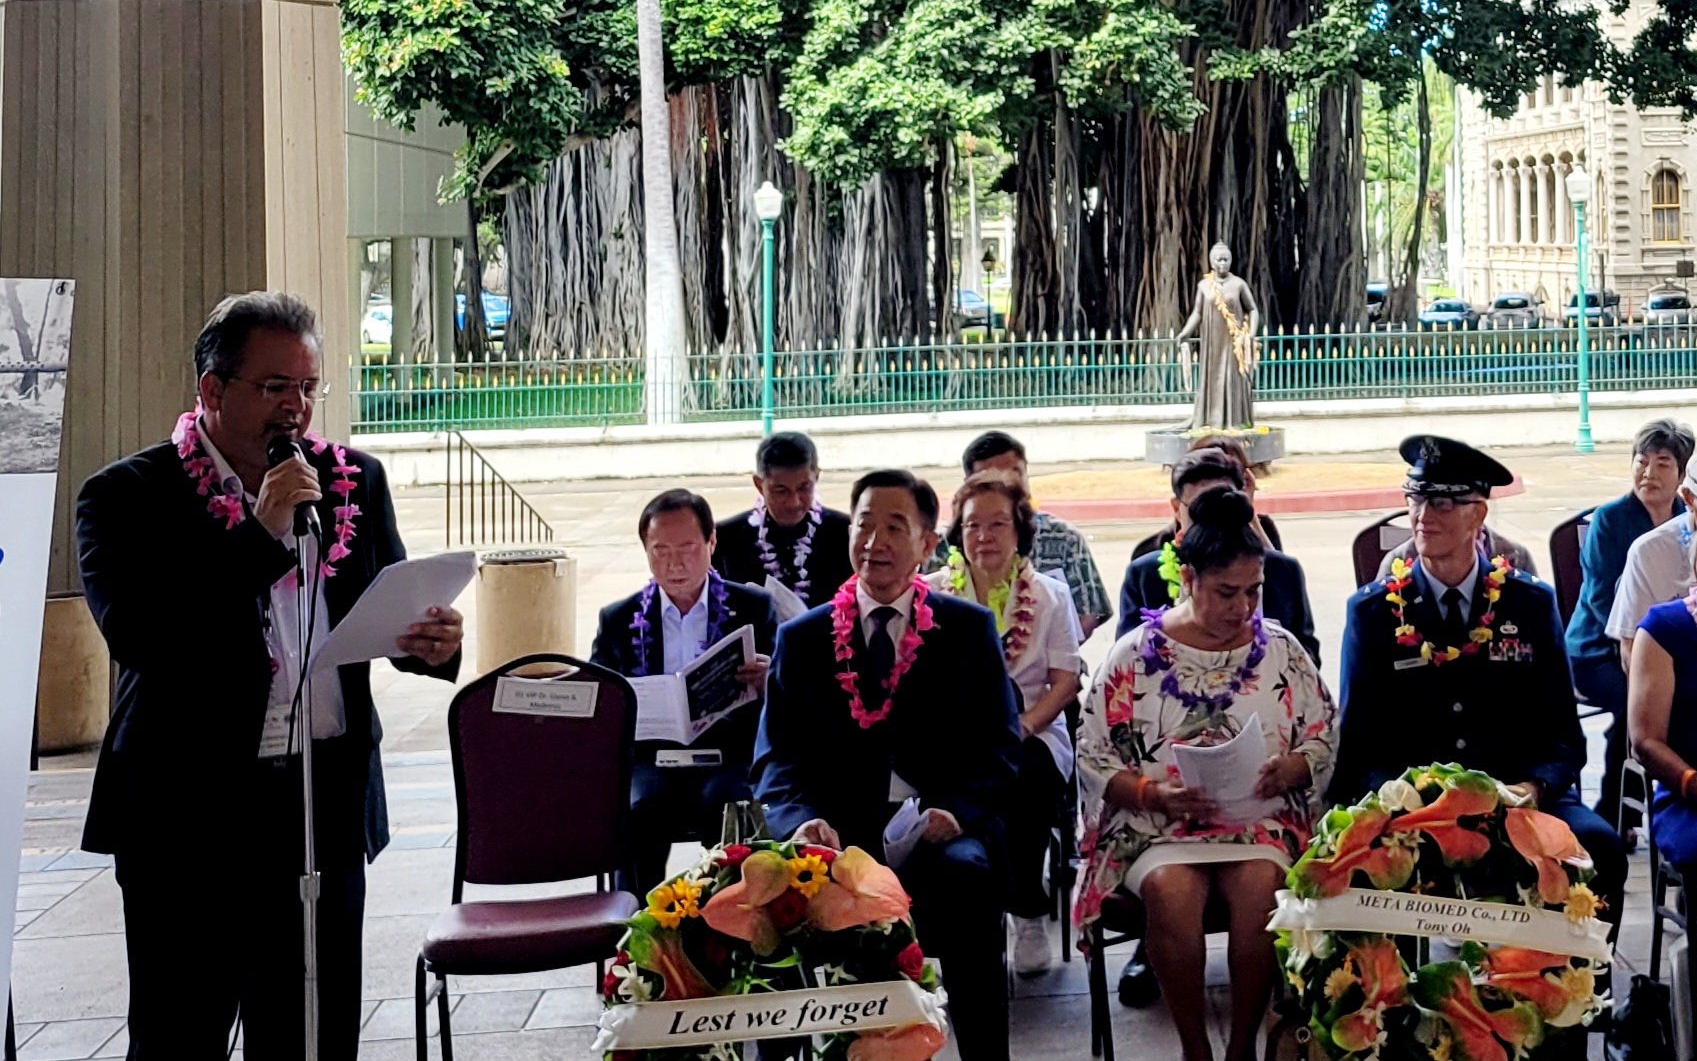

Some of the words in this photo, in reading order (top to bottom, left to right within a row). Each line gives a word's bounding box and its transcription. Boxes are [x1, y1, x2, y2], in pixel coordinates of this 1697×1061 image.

[1357, 894, 1400, 910] META
[1405, 900, 1467, 917] BIOMED
[1472, 907, 1496, 921] Co.,
[1501, 909, 1531, 923] LTD
[1416, 918, 1448, 934] Tony
[1452, 922, 1471, 934] Oh
[668, 1009, 737, 1035] Lest
[746, 1008, 787, 1028] we
[790, 995, 889, 1031] forget
